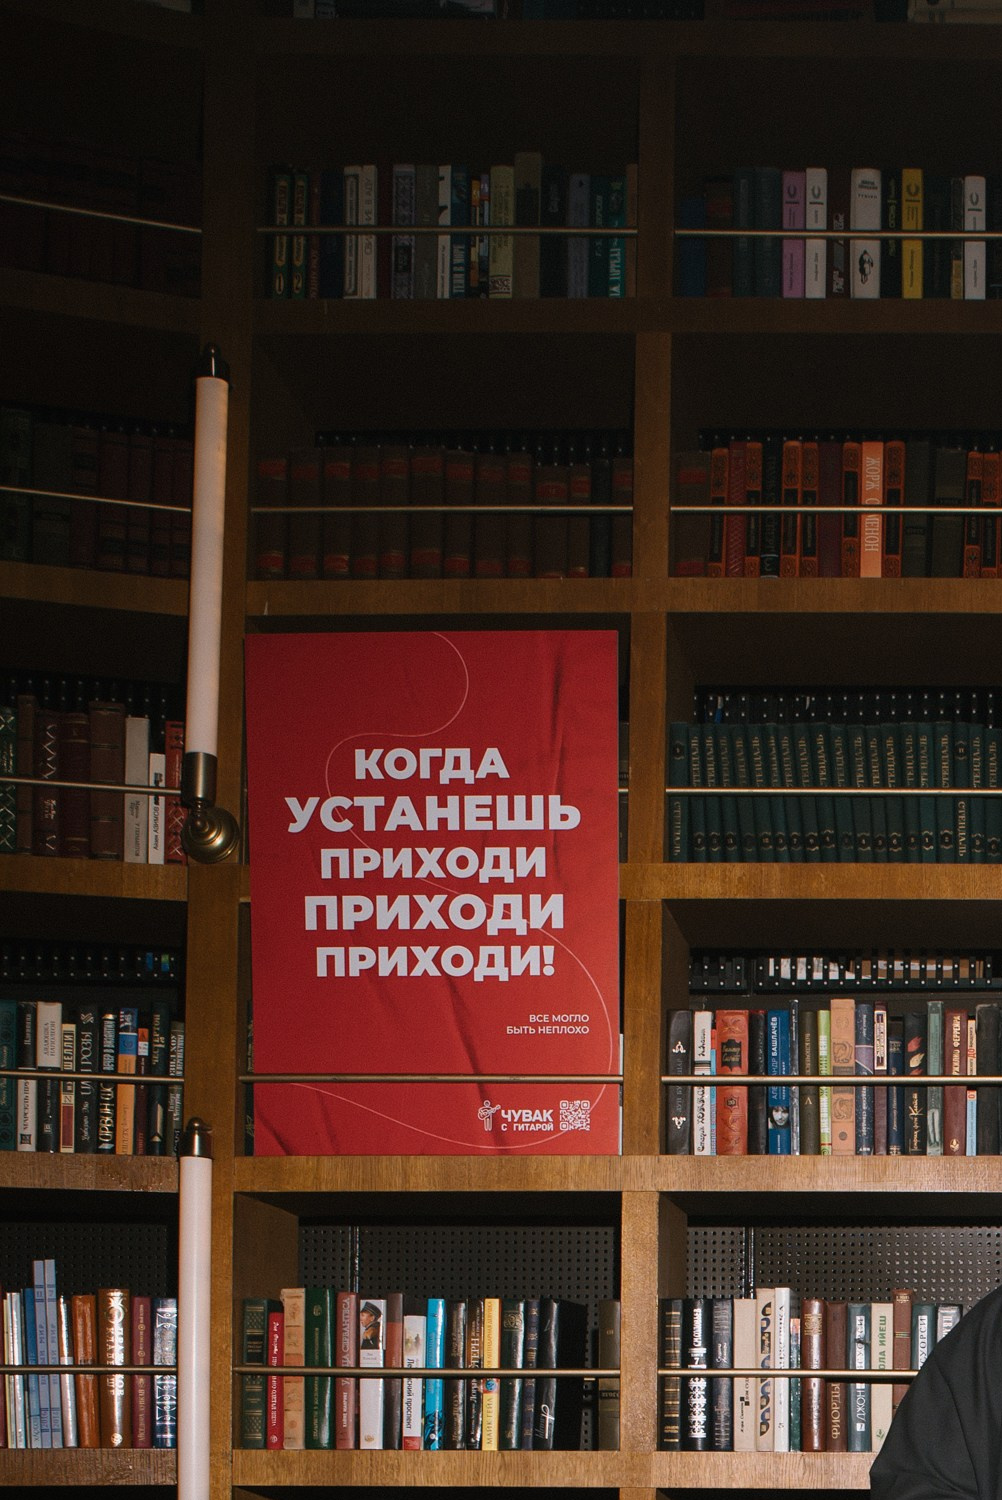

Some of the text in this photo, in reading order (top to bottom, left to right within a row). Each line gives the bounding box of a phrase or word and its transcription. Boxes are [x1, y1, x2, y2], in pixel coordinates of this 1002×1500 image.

[354, 747, 510, 785] КОГДА
[691, 736, 701, 787] ТЕНДАЛЬ
[284, 794, 581, 834] УСТАНЕШЬ
[320, 847, 547, 883] ПРИХОДИ
[304, 893, 564, 936] ПРИХОДИ
[316, 945, 556, 982] ПРИХОДИ!
[506, 1026, 590, 1035] БЫТЬ НЕПЛОХО
[529, 1014, 590, 1023] ВСЕ МОГЛО
[769, 1016, 779, 1057] БАШЛАЧЁВ
[951, 1015, 961, 1048] ФЕРРЕЙРА
[64, 1034, 75, 1072] ШЕЛЛИ
[81, 1033, 96, 1066] РОЗЫ
[501, 1109, 554, 1122] ЧУВАК
[513, 1123, 554, 1132] ГИТАРОЙ
[339, 1297, 352, 1352] СЕРВАНТЕСА
[877, 1315, 887, 1347] ИЙЕШ
[405, 1398, 415, 1430] проспект
[485, 1397, 494, 1445] МАЙК ГЕЙЛ
[830, 1383, 841, 1440] ФИОРДЫ
[856, 1388, 866, 1423] ДЖОН
